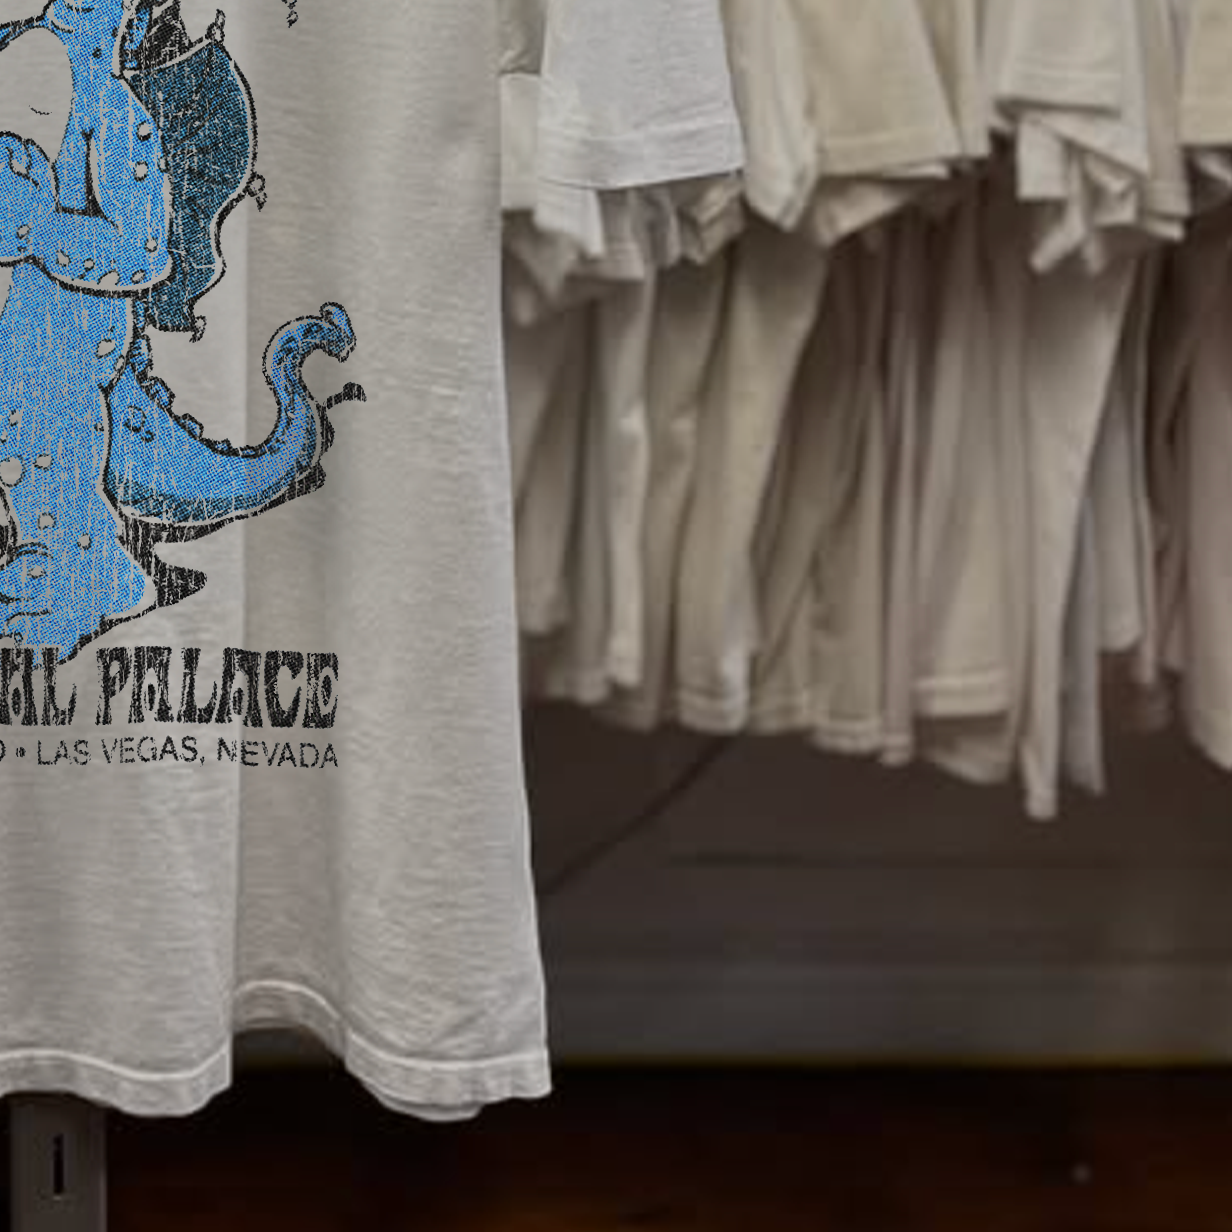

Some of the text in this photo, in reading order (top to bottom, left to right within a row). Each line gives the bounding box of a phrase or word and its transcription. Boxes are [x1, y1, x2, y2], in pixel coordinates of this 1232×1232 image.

[95, 644, 340, 729] PALACE
[36, 738, 92, 766] LAS
[101, 735, 206, 767] VEGAS,
[217, 735, 340, 769] NEVADA
